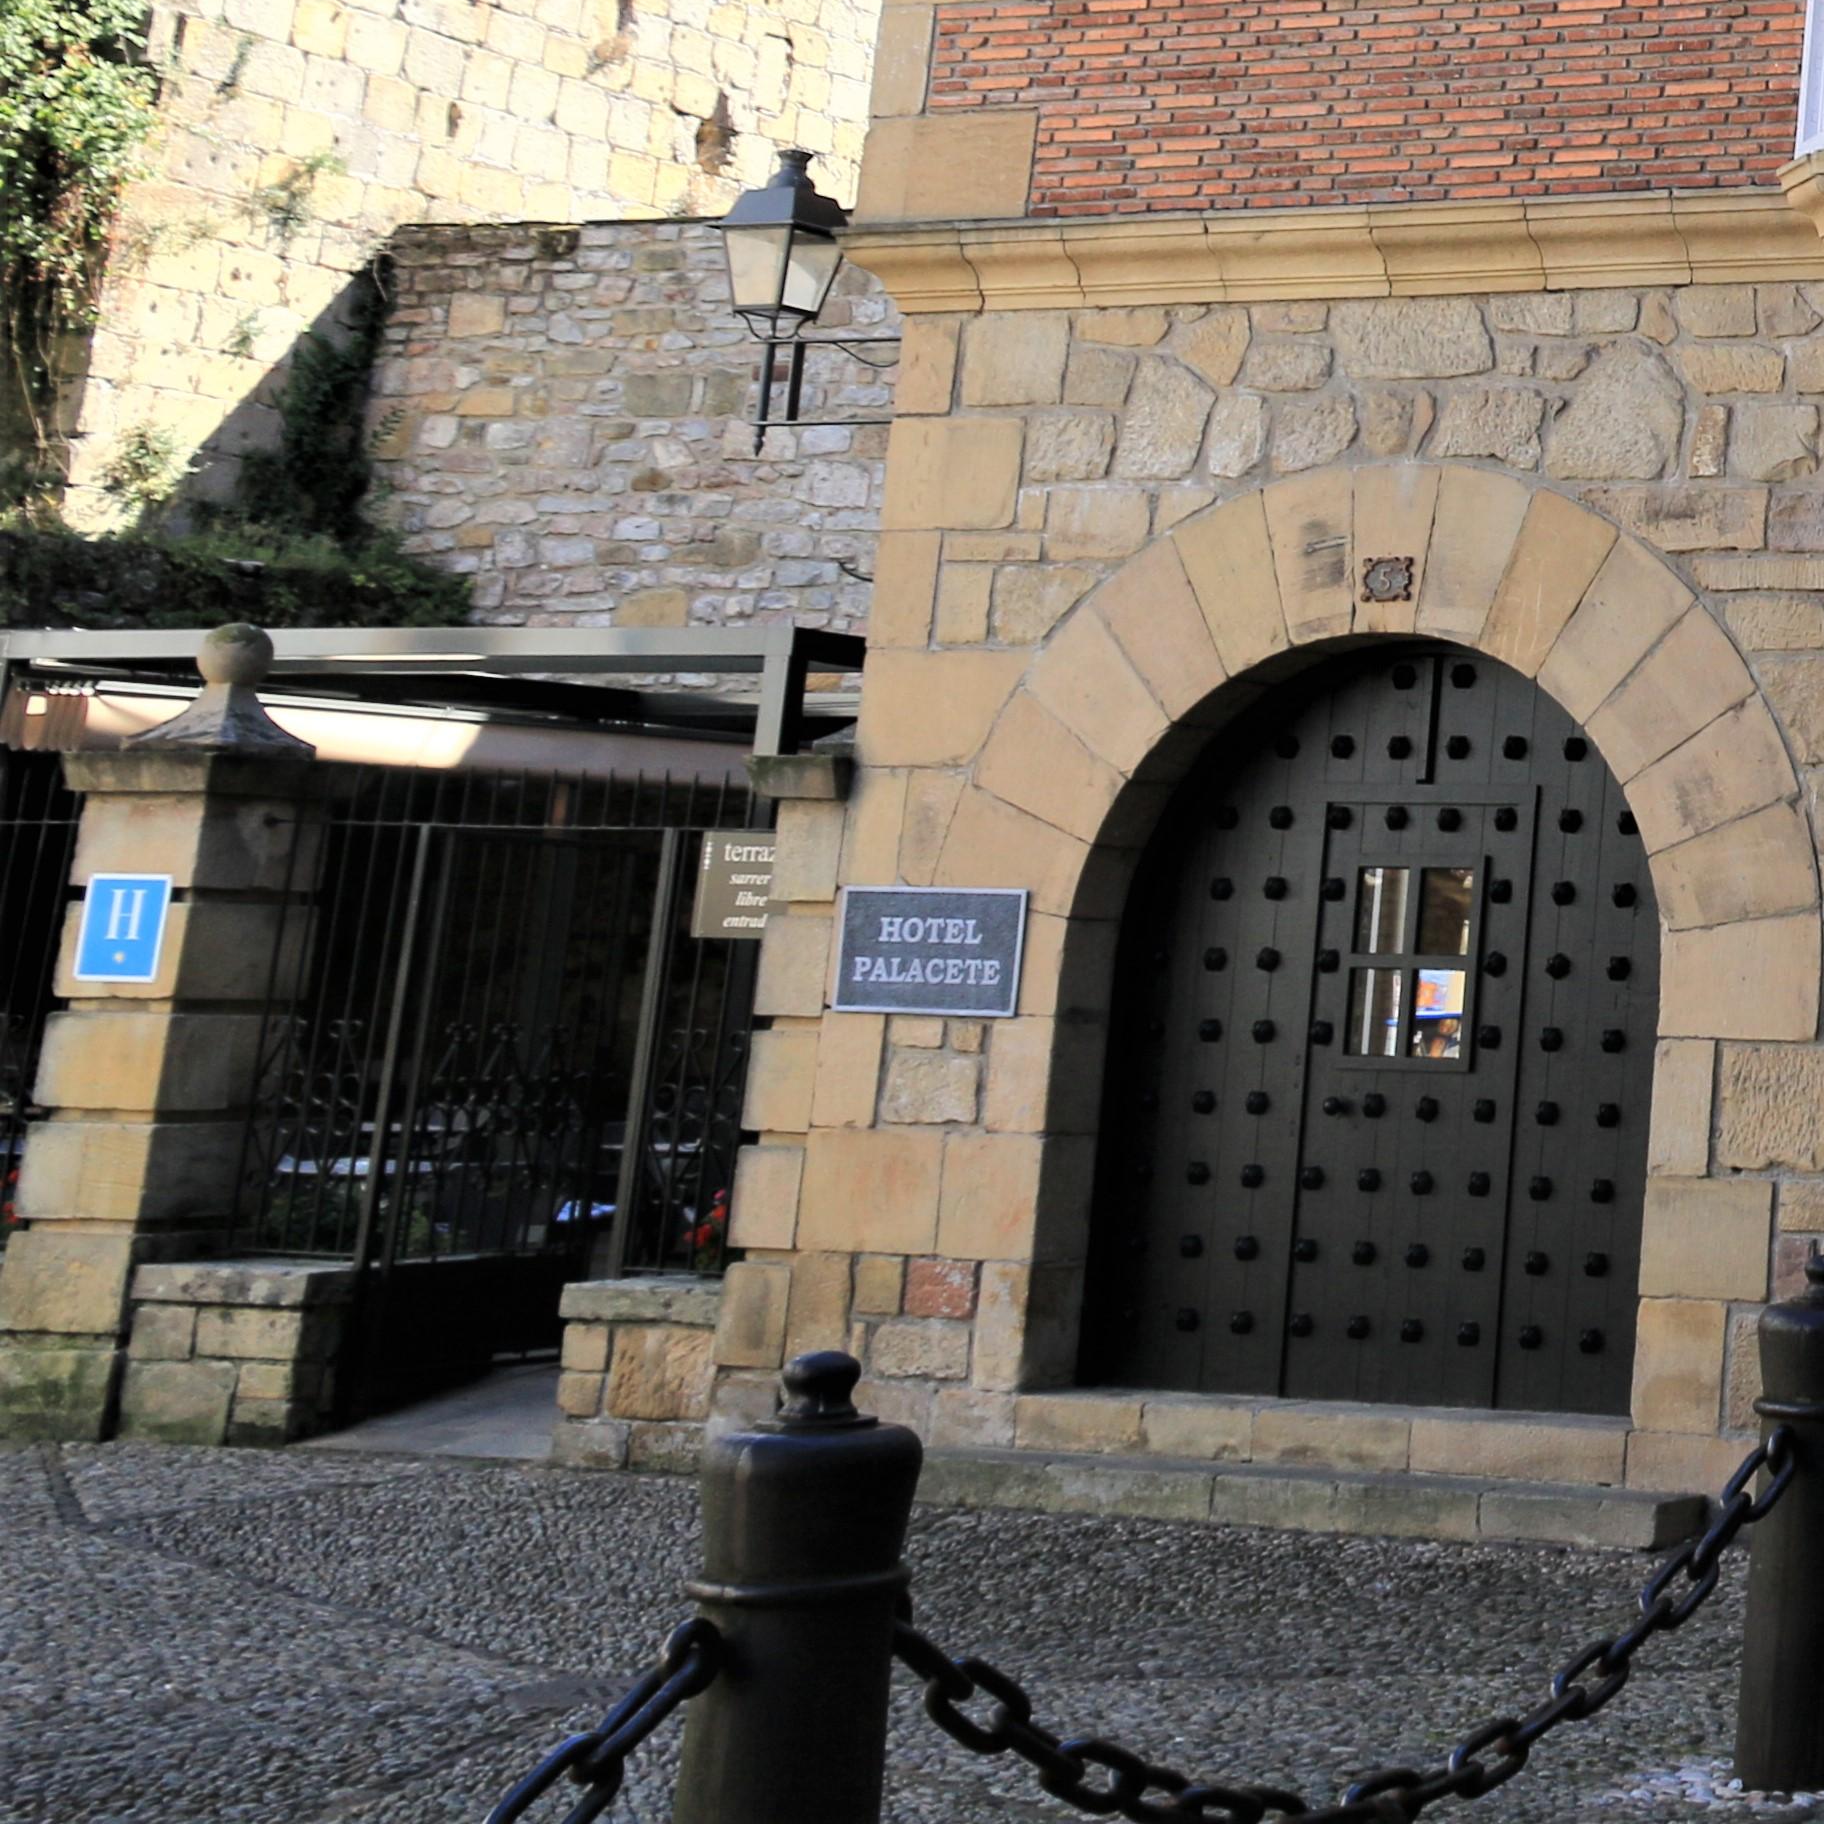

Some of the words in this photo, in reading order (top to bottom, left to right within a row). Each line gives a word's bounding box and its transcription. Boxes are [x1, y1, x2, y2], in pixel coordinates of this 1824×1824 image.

[1379, 567, 1392, 593] 5
[724, 842, 776, 863] terraz
[729, 872, 772, 886] sarrer
[104, 888, 148, 940] H
[722, 914, 769, 928] entrad
[878, 916, 983, 945] HOTEL
[852, 956, 1001, 986] PALACETE
